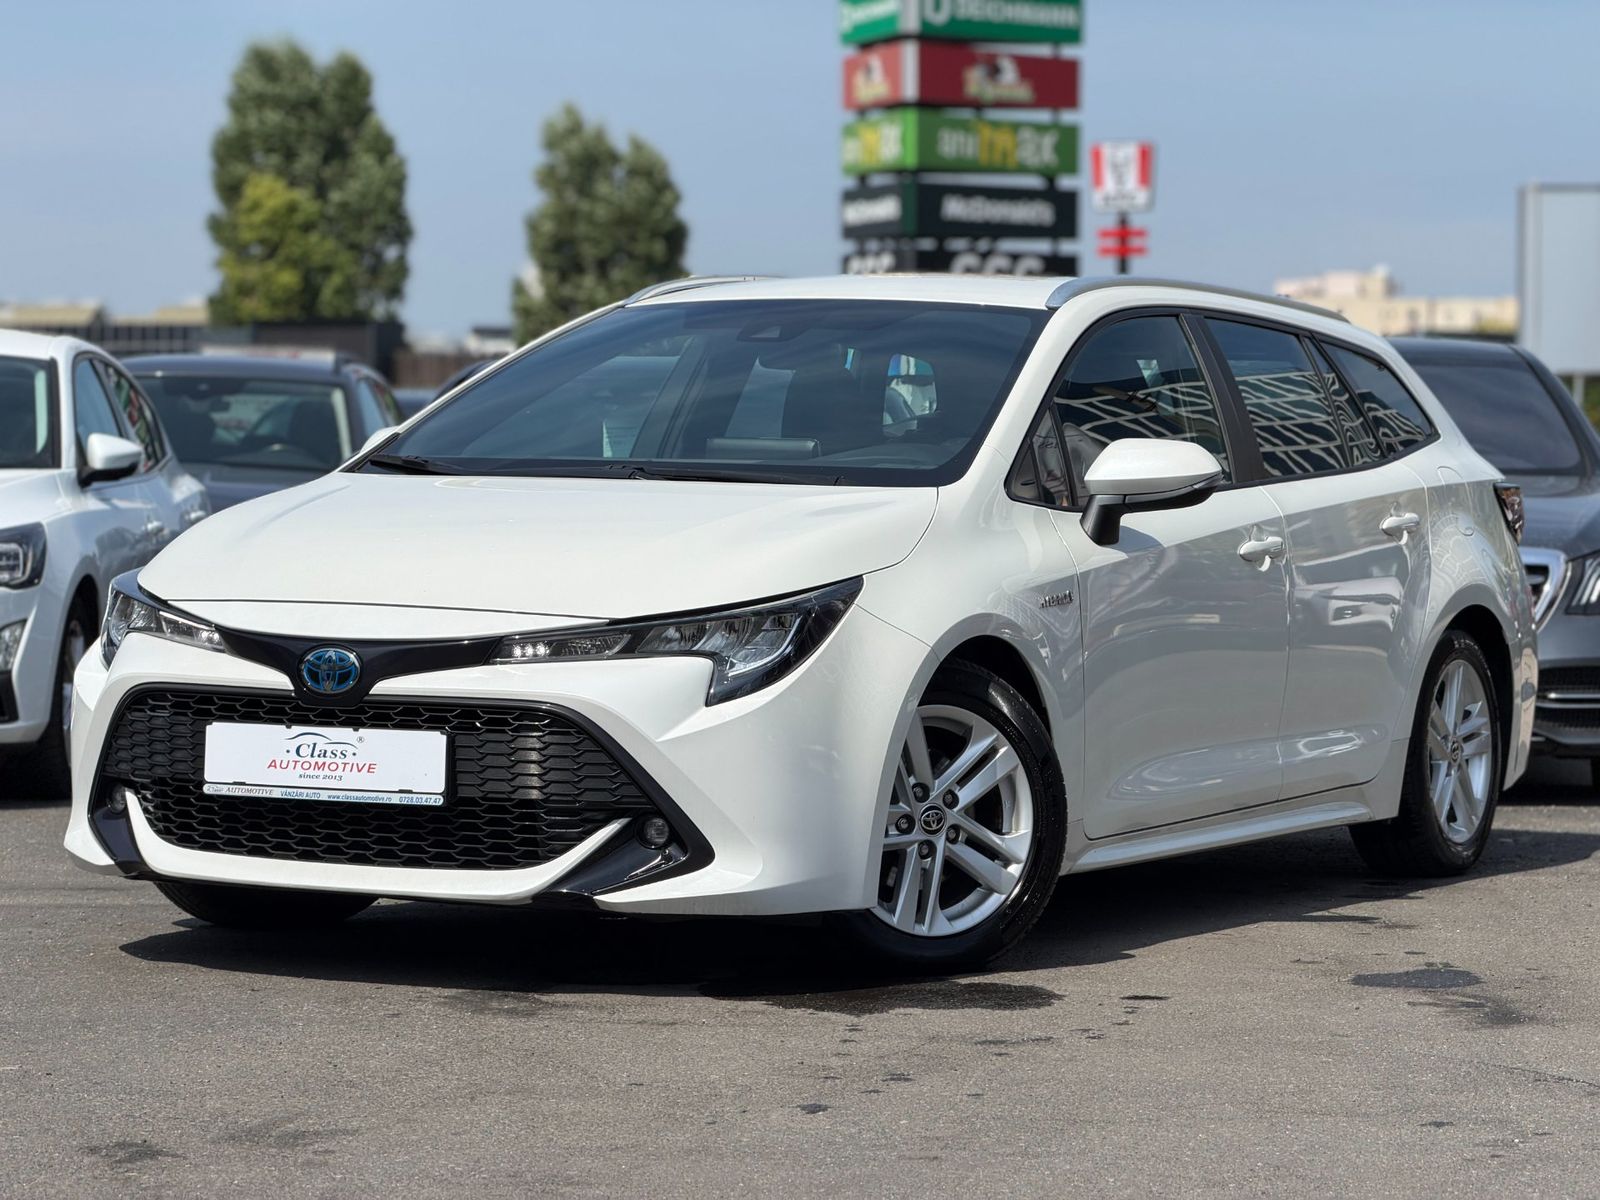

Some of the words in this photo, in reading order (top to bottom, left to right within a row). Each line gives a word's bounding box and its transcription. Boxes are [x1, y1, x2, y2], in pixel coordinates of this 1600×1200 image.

[936, 121, 1060, 169] animax
[295, 743, 348, 759] Class
[267, 759, 377, 773] AUTOMOTIVE
[226, 787, 273, 795] AUTOMOTIVE
[305, 791, 321, 799] AUTO
[327, 794, 392, 802] www.classautomotive.ro
[398, 796, 441, 805] 0728.03.47.47
